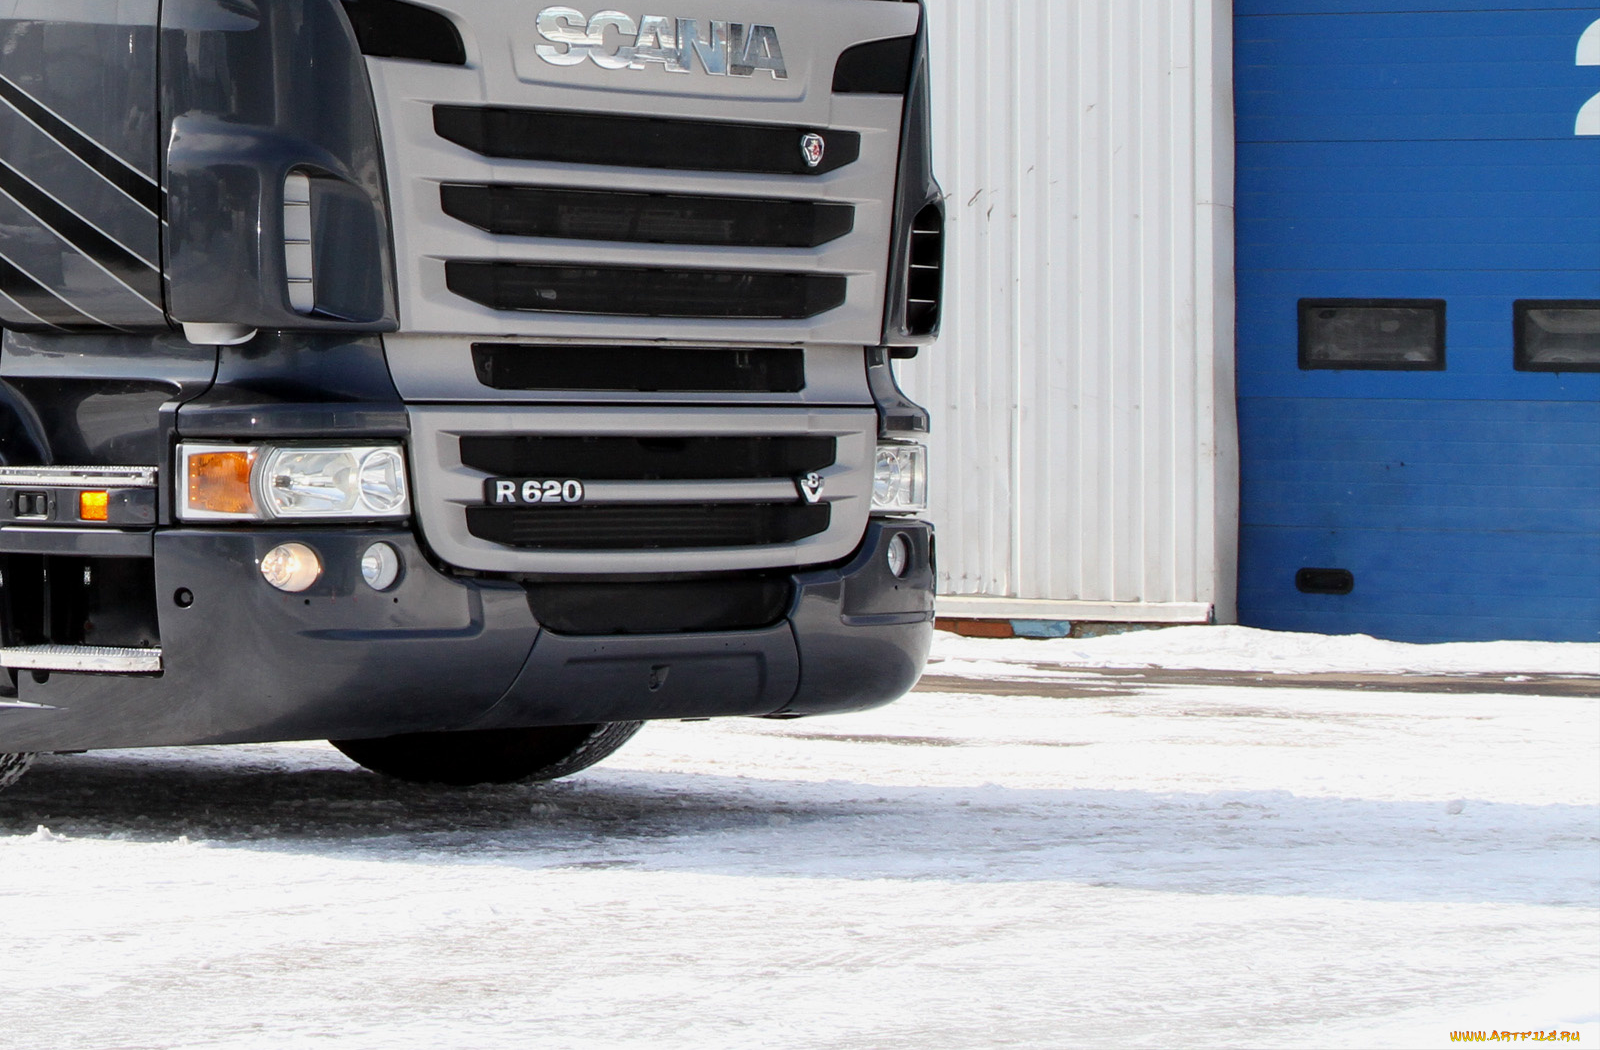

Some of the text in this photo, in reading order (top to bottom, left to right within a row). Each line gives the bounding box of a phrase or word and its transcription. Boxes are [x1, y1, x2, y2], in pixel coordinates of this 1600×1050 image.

[533, 5, 789, 80] SCANIA
[495, 479, 583, 503] R 620
